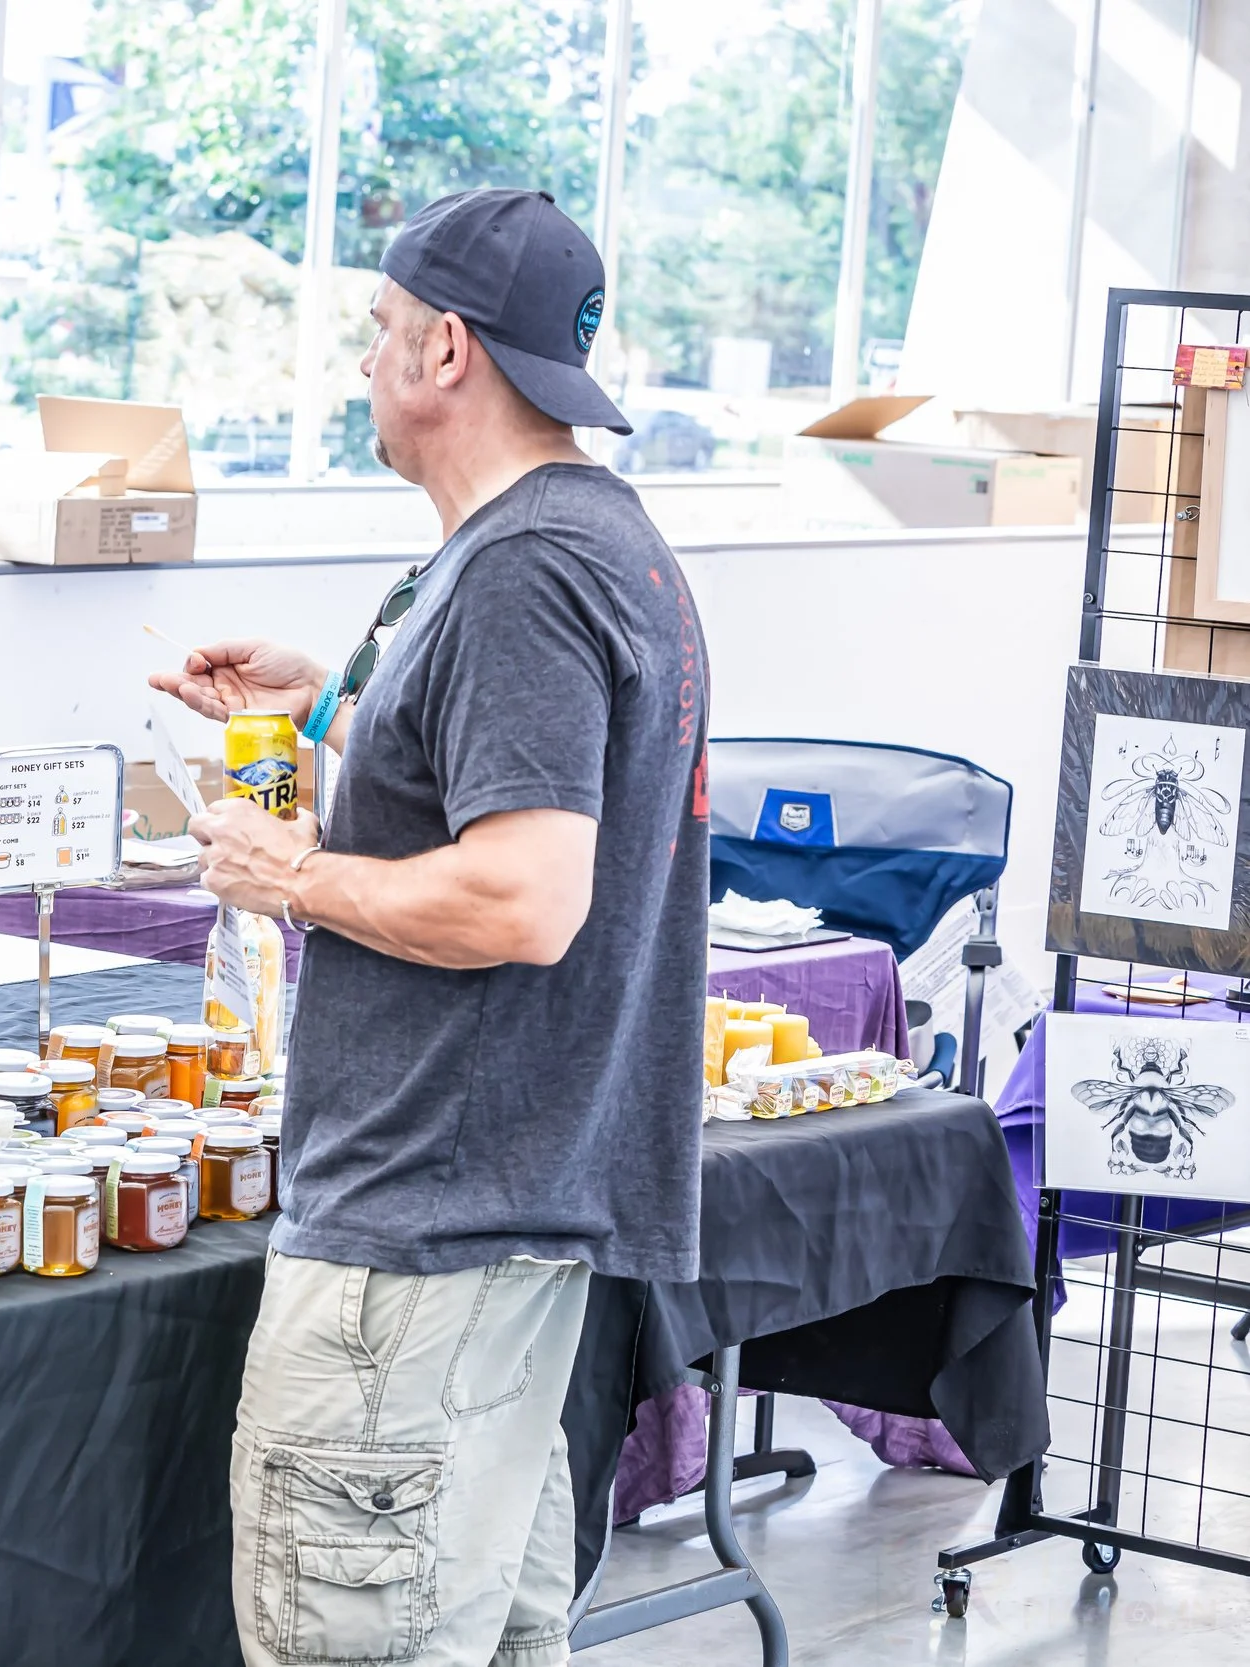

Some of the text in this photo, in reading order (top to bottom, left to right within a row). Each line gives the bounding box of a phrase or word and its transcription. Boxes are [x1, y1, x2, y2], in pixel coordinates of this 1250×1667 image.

[308, 690, 334, 737] EXPERIENCE
[11, 760, 85, 773] HONEY GIFT SETS
[240, 1171, 266, 1182] HONEY
[157, 1201, 182, 1212] HONEY
